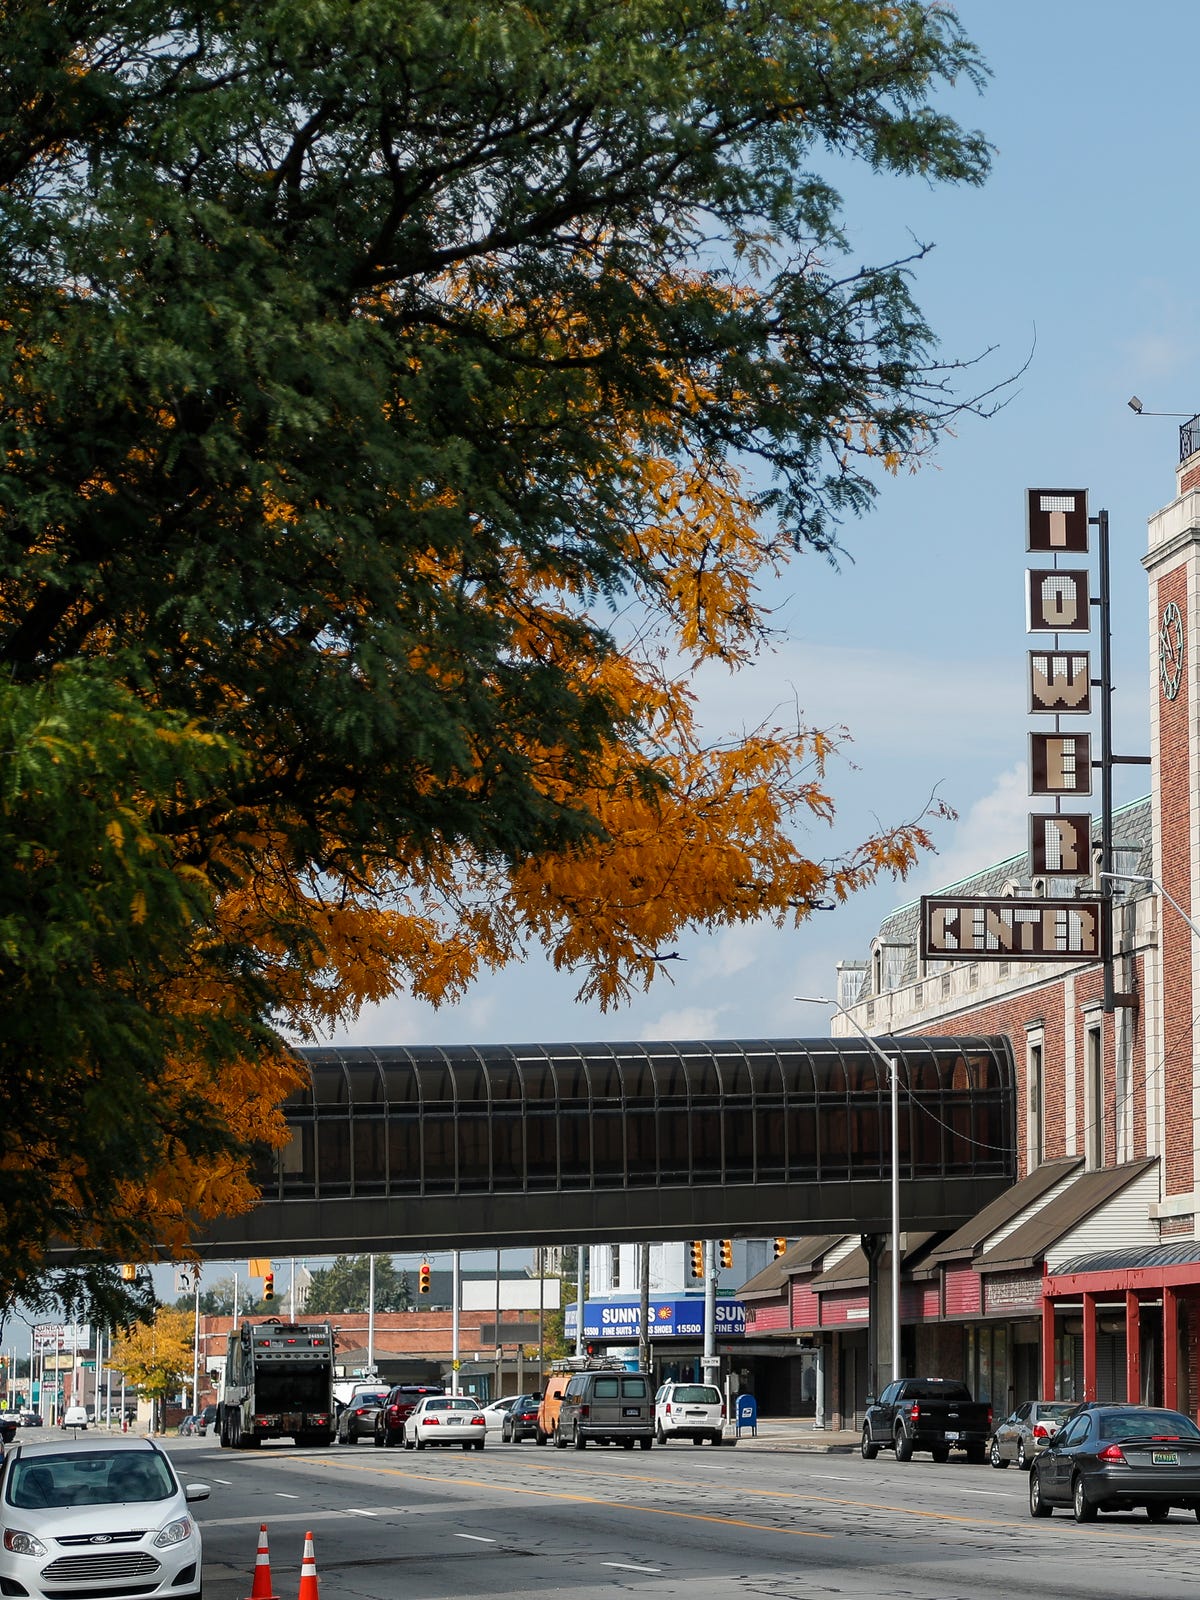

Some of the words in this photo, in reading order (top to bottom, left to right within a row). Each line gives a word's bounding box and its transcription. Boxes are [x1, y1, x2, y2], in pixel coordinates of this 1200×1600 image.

[1031, 495, 1089, 870] TOWER
[931, 907, 1095, 951] CENTER
[583, 1327, 599, 1336] 15500
[602, 1326, 615, 1336] FINE
[615, 1325, 632, 1336] SUITS
[654, 1325, 673, 1334] SHOES
[676, 1324, 701, 1333] 15500
[714, 1324, 732, 1332] FINE
[602, 1306, 656, 1324] SUNNYS
